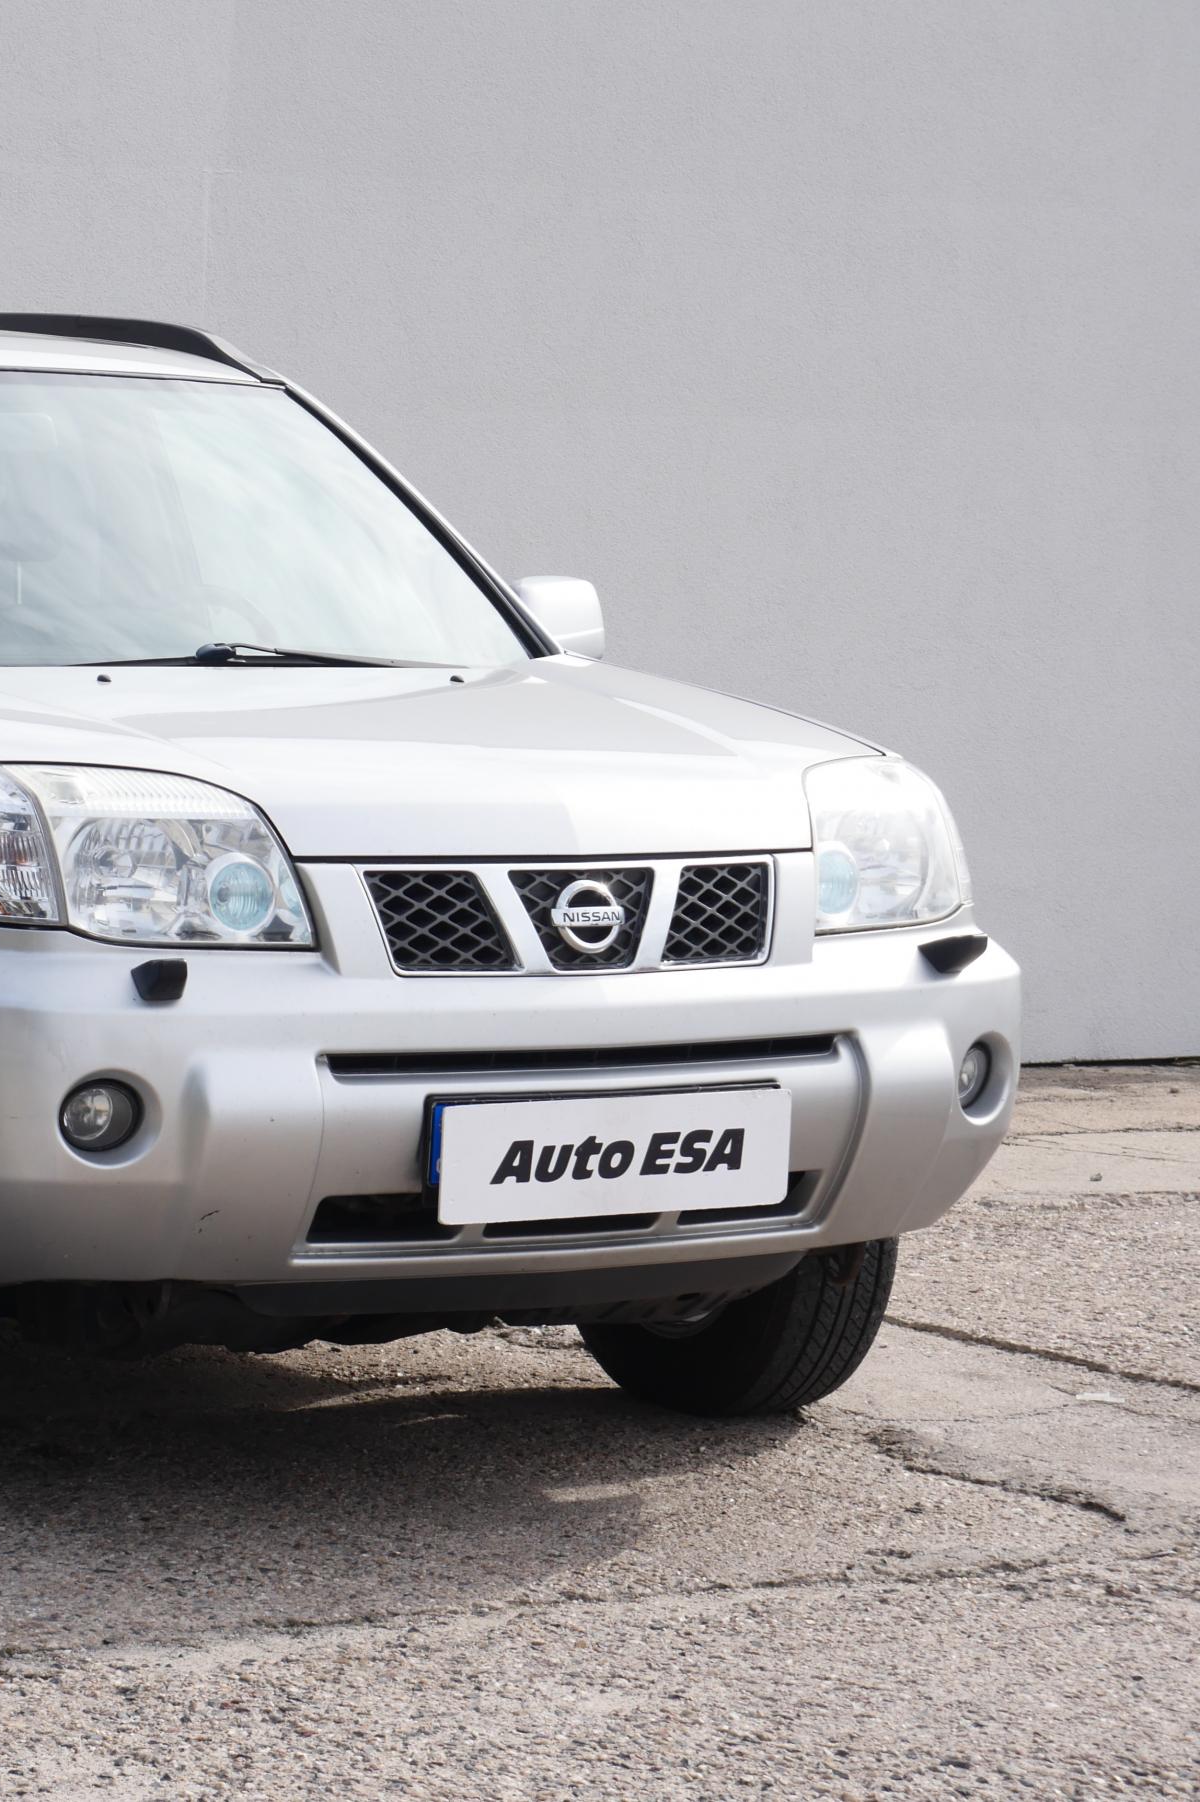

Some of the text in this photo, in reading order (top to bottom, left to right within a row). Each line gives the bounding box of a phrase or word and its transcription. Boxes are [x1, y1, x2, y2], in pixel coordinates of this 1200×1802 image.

[563, 911, 620, 923] NISSAN
[490, 1128, 745, 1185] Auto ESA
